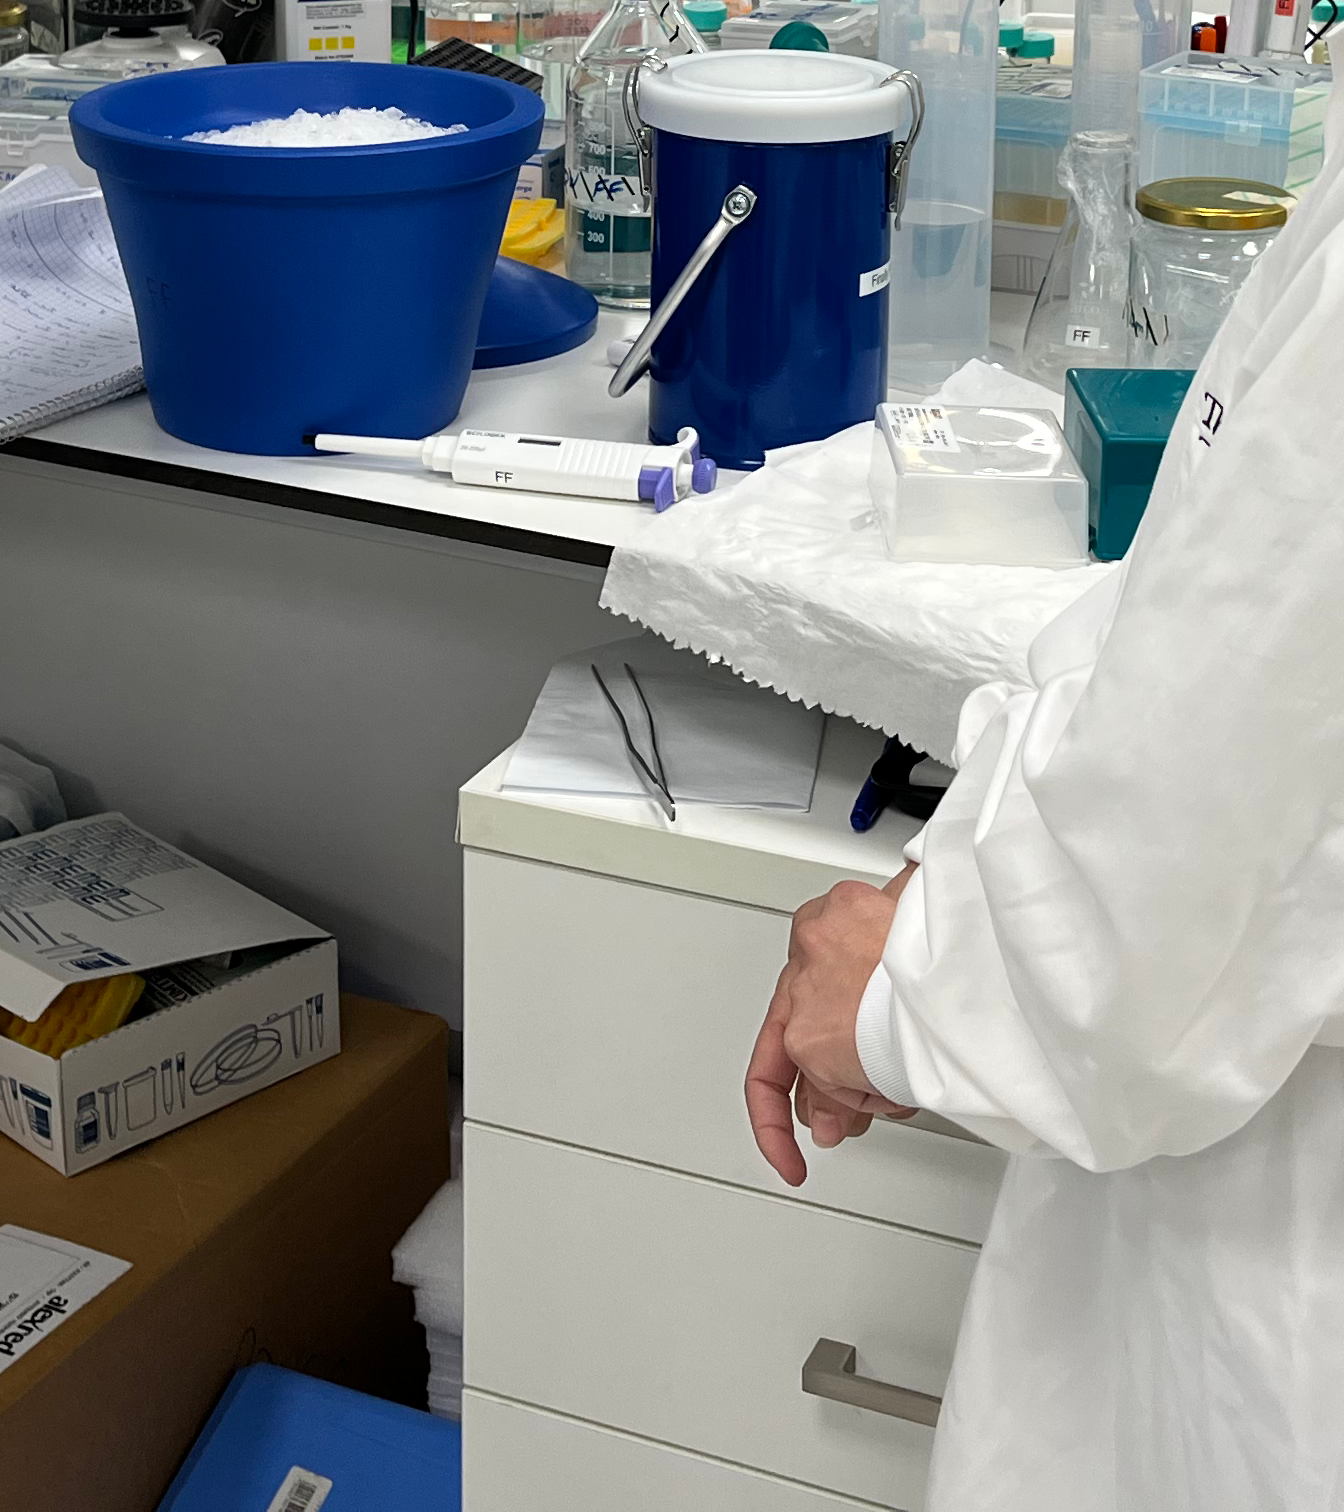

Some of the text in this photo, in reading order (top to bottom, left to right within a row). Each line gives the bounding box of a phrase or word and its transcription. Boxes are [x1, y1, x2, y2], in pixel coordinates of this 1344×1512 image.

[588, 143, 606, 155] 700
[587, 232, 605, 244] 300
[1073, 328, 1091, 343] FF
[495, 470, 514, 484] FF
